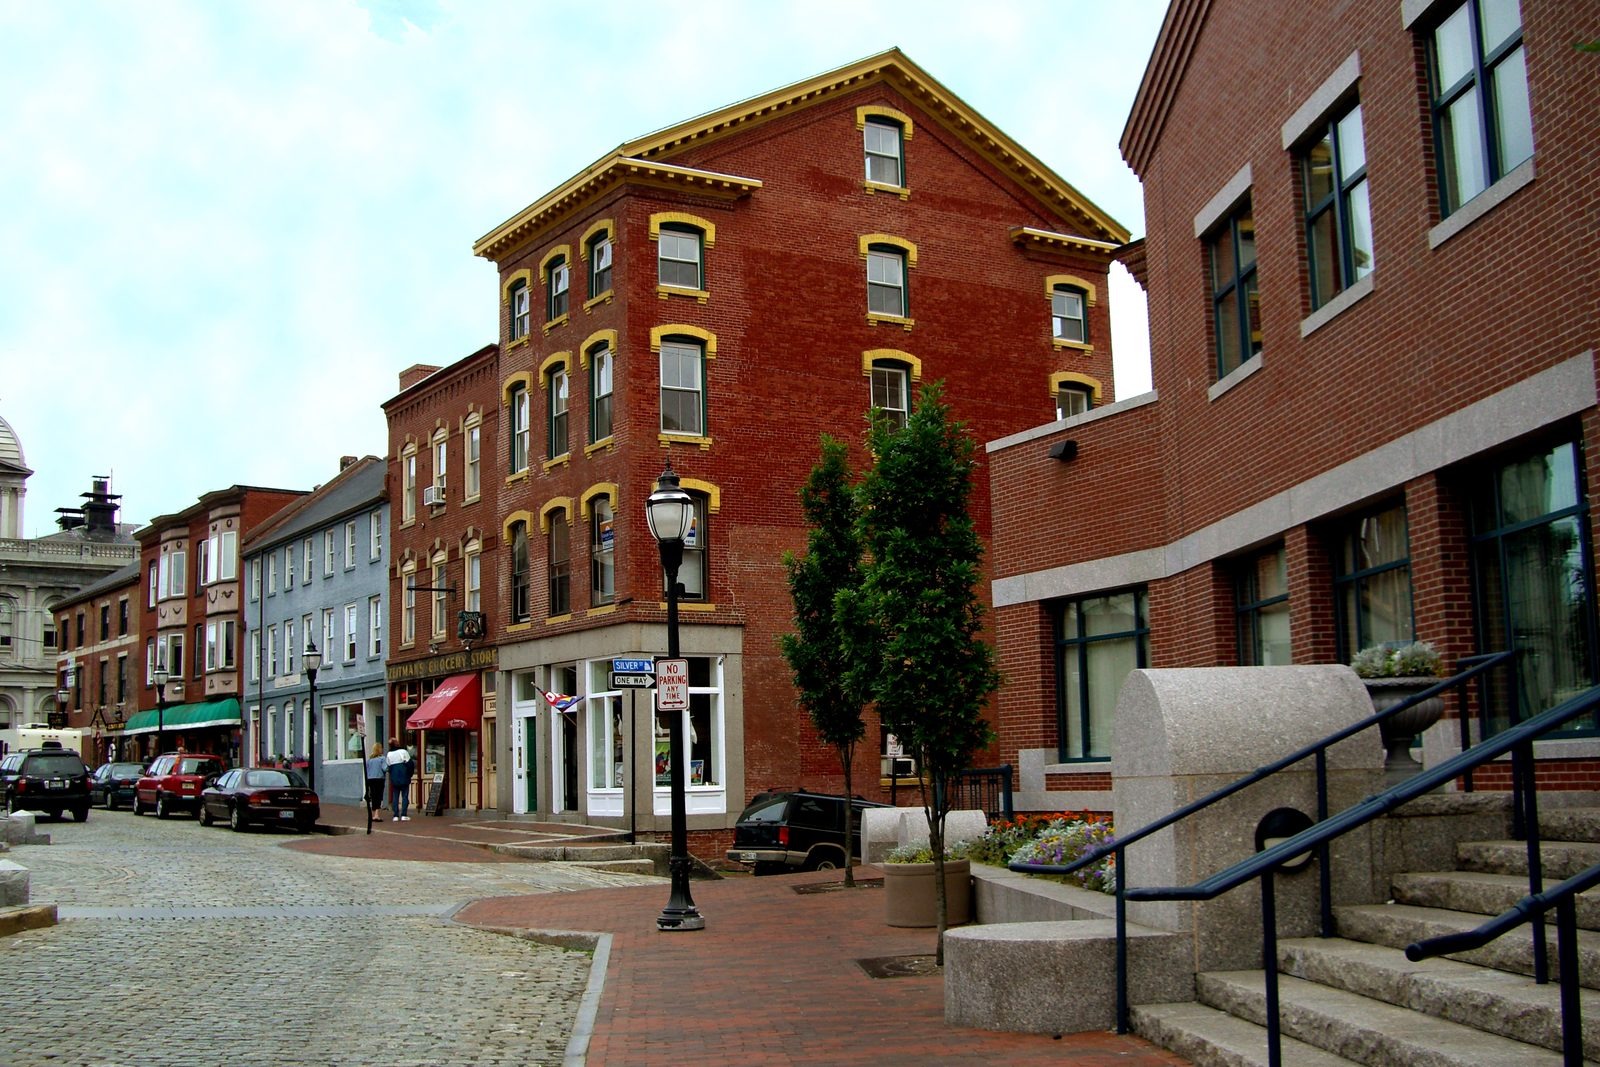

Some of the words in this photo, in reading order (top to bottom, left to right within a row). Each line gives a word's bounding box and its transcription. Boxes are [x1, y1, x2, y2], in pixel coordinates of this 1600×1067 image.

[428, 655, 466, 673] GROCERY
[471, 649, 497, 665] STORE
[615, 661, 639, 670] SILVER
[666, 664, 679, 674] NO
[659, 675, 686, 685] PARKING
